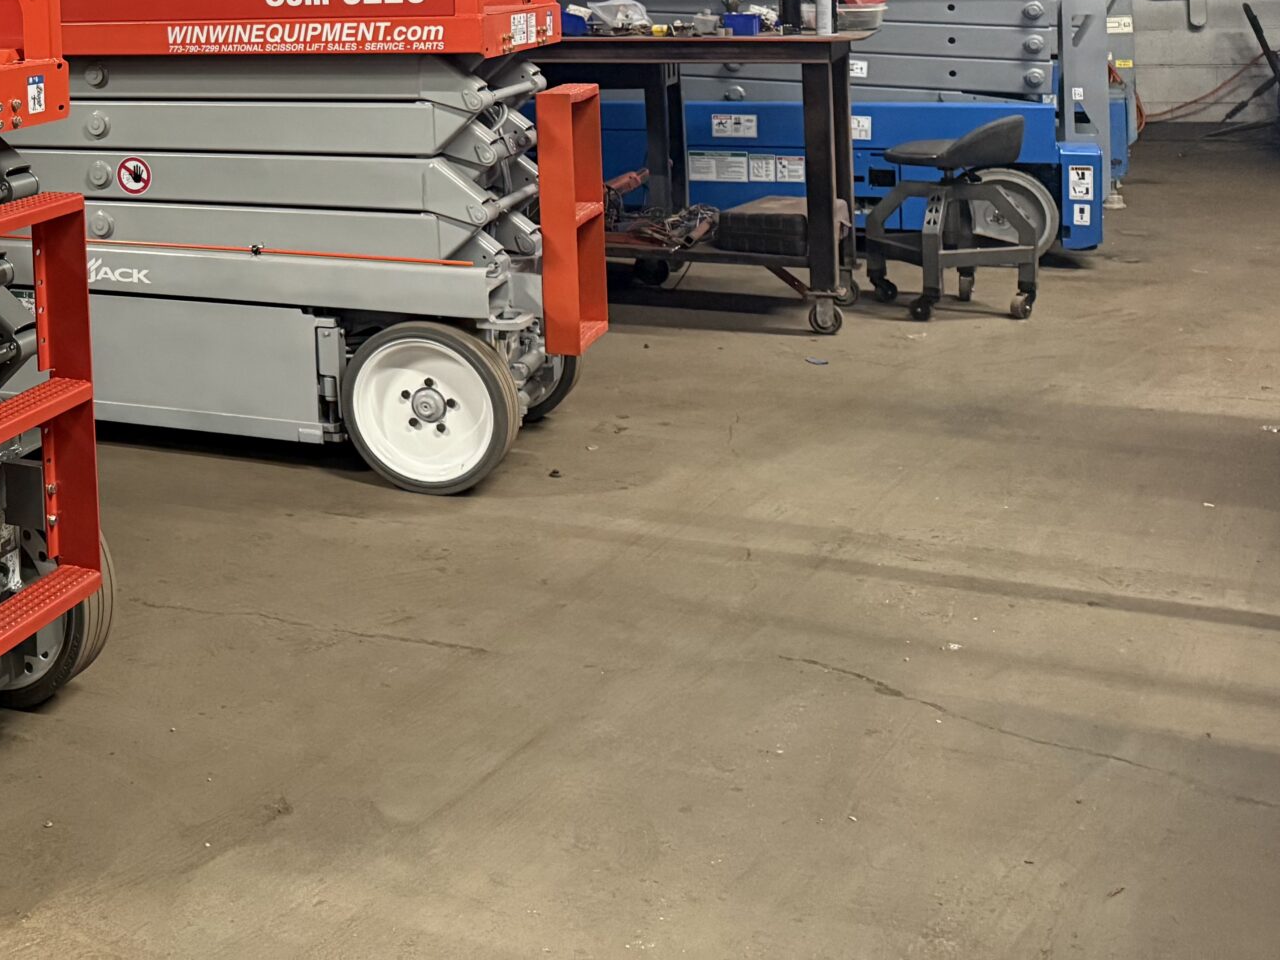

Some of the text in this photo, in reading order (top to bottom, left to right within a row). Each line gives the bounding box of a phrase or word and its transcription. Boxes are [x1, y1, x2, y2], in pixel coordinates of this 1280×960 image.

[167, 21, 444, 44] WINWINEQUIPMENT.com
[169, 45, 219, 53] 773-790-7299
[221, 44, 263, 52] NATIONAL
[265, 43, 304, 52] SCISSOR
[306, 43, 325, 51] LIFT
[327, 42, 357, 51] SALES
[364, 41, 405, 51] SERVICE
[412, 41, 444, 50] PARTS
